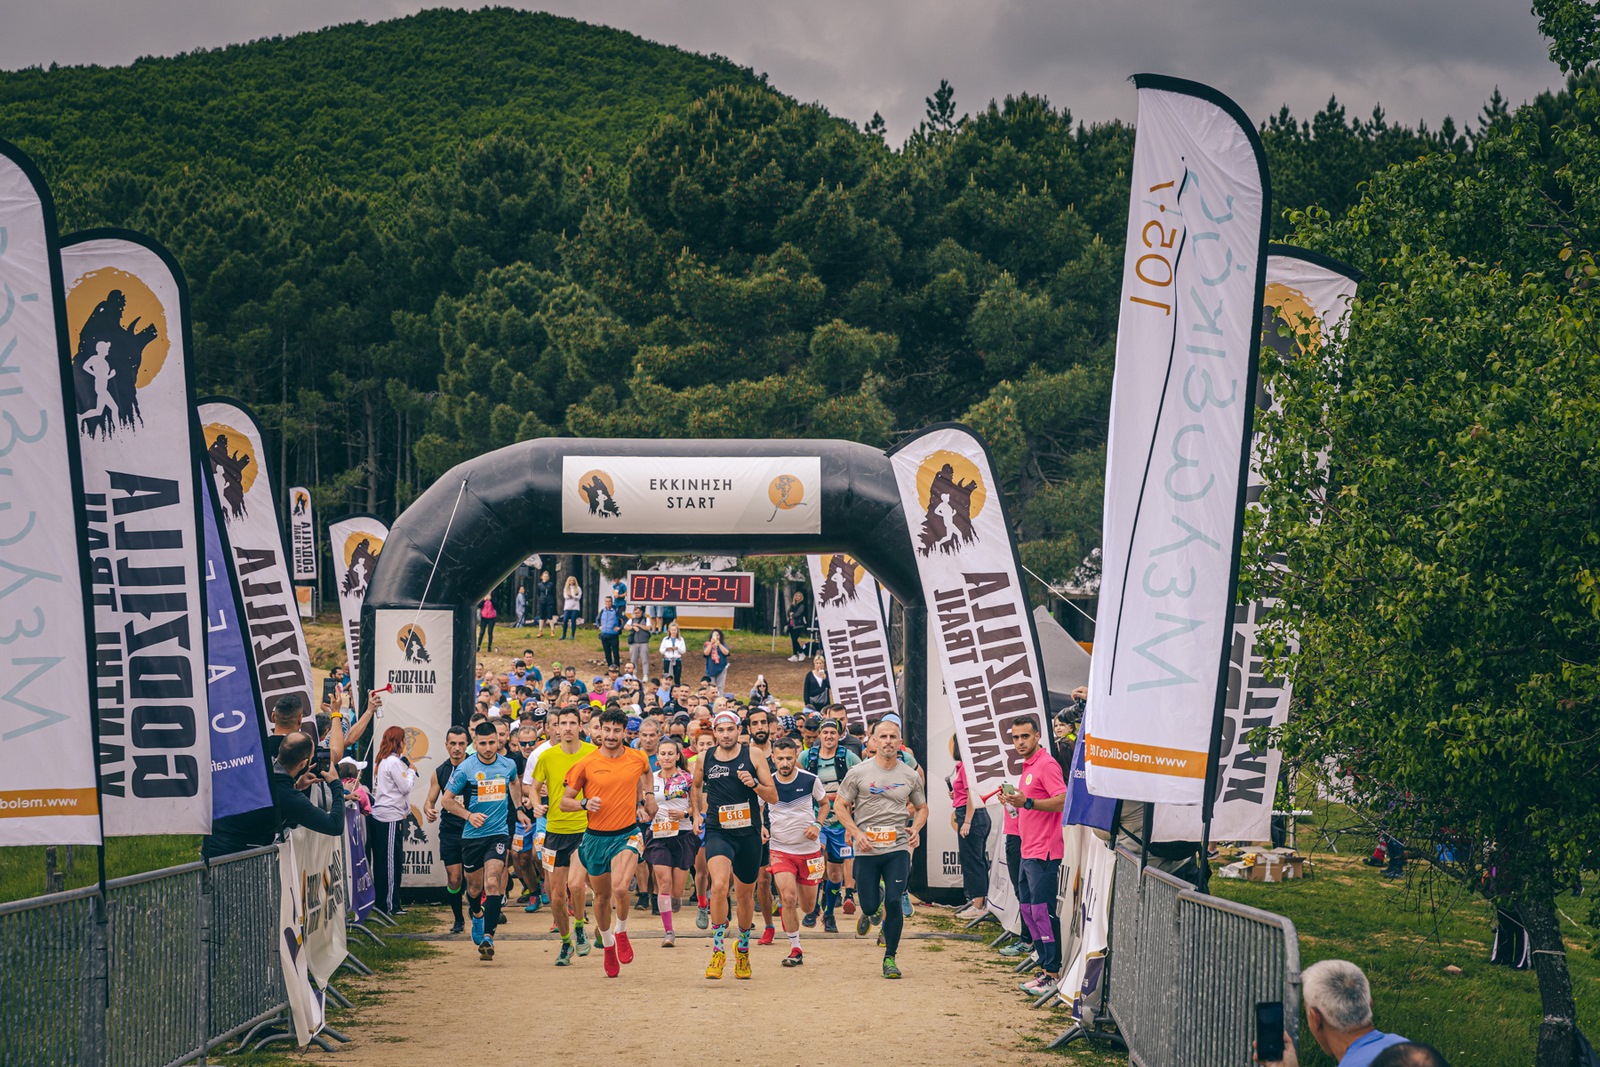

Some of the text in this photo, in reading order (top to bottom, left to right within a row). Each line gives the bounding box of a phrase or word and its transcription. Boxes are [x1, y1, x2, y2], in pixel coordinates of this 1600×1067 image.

[649, 478, 732, 491] ΕΚΚΙΝΗΣΗ
[667, 497, 715, 509] START
[632, 575, 739, 602] 00:48:24
[388, 670, 437, 684] GODZILLA
[415, 684, 434, 694] TRAIL
[485, 785, 499, 794] 551
[726, 810, 744, 820] 618
[658, 822, 672, 830] 519
[412, 865, 431, 875] TRAIL
